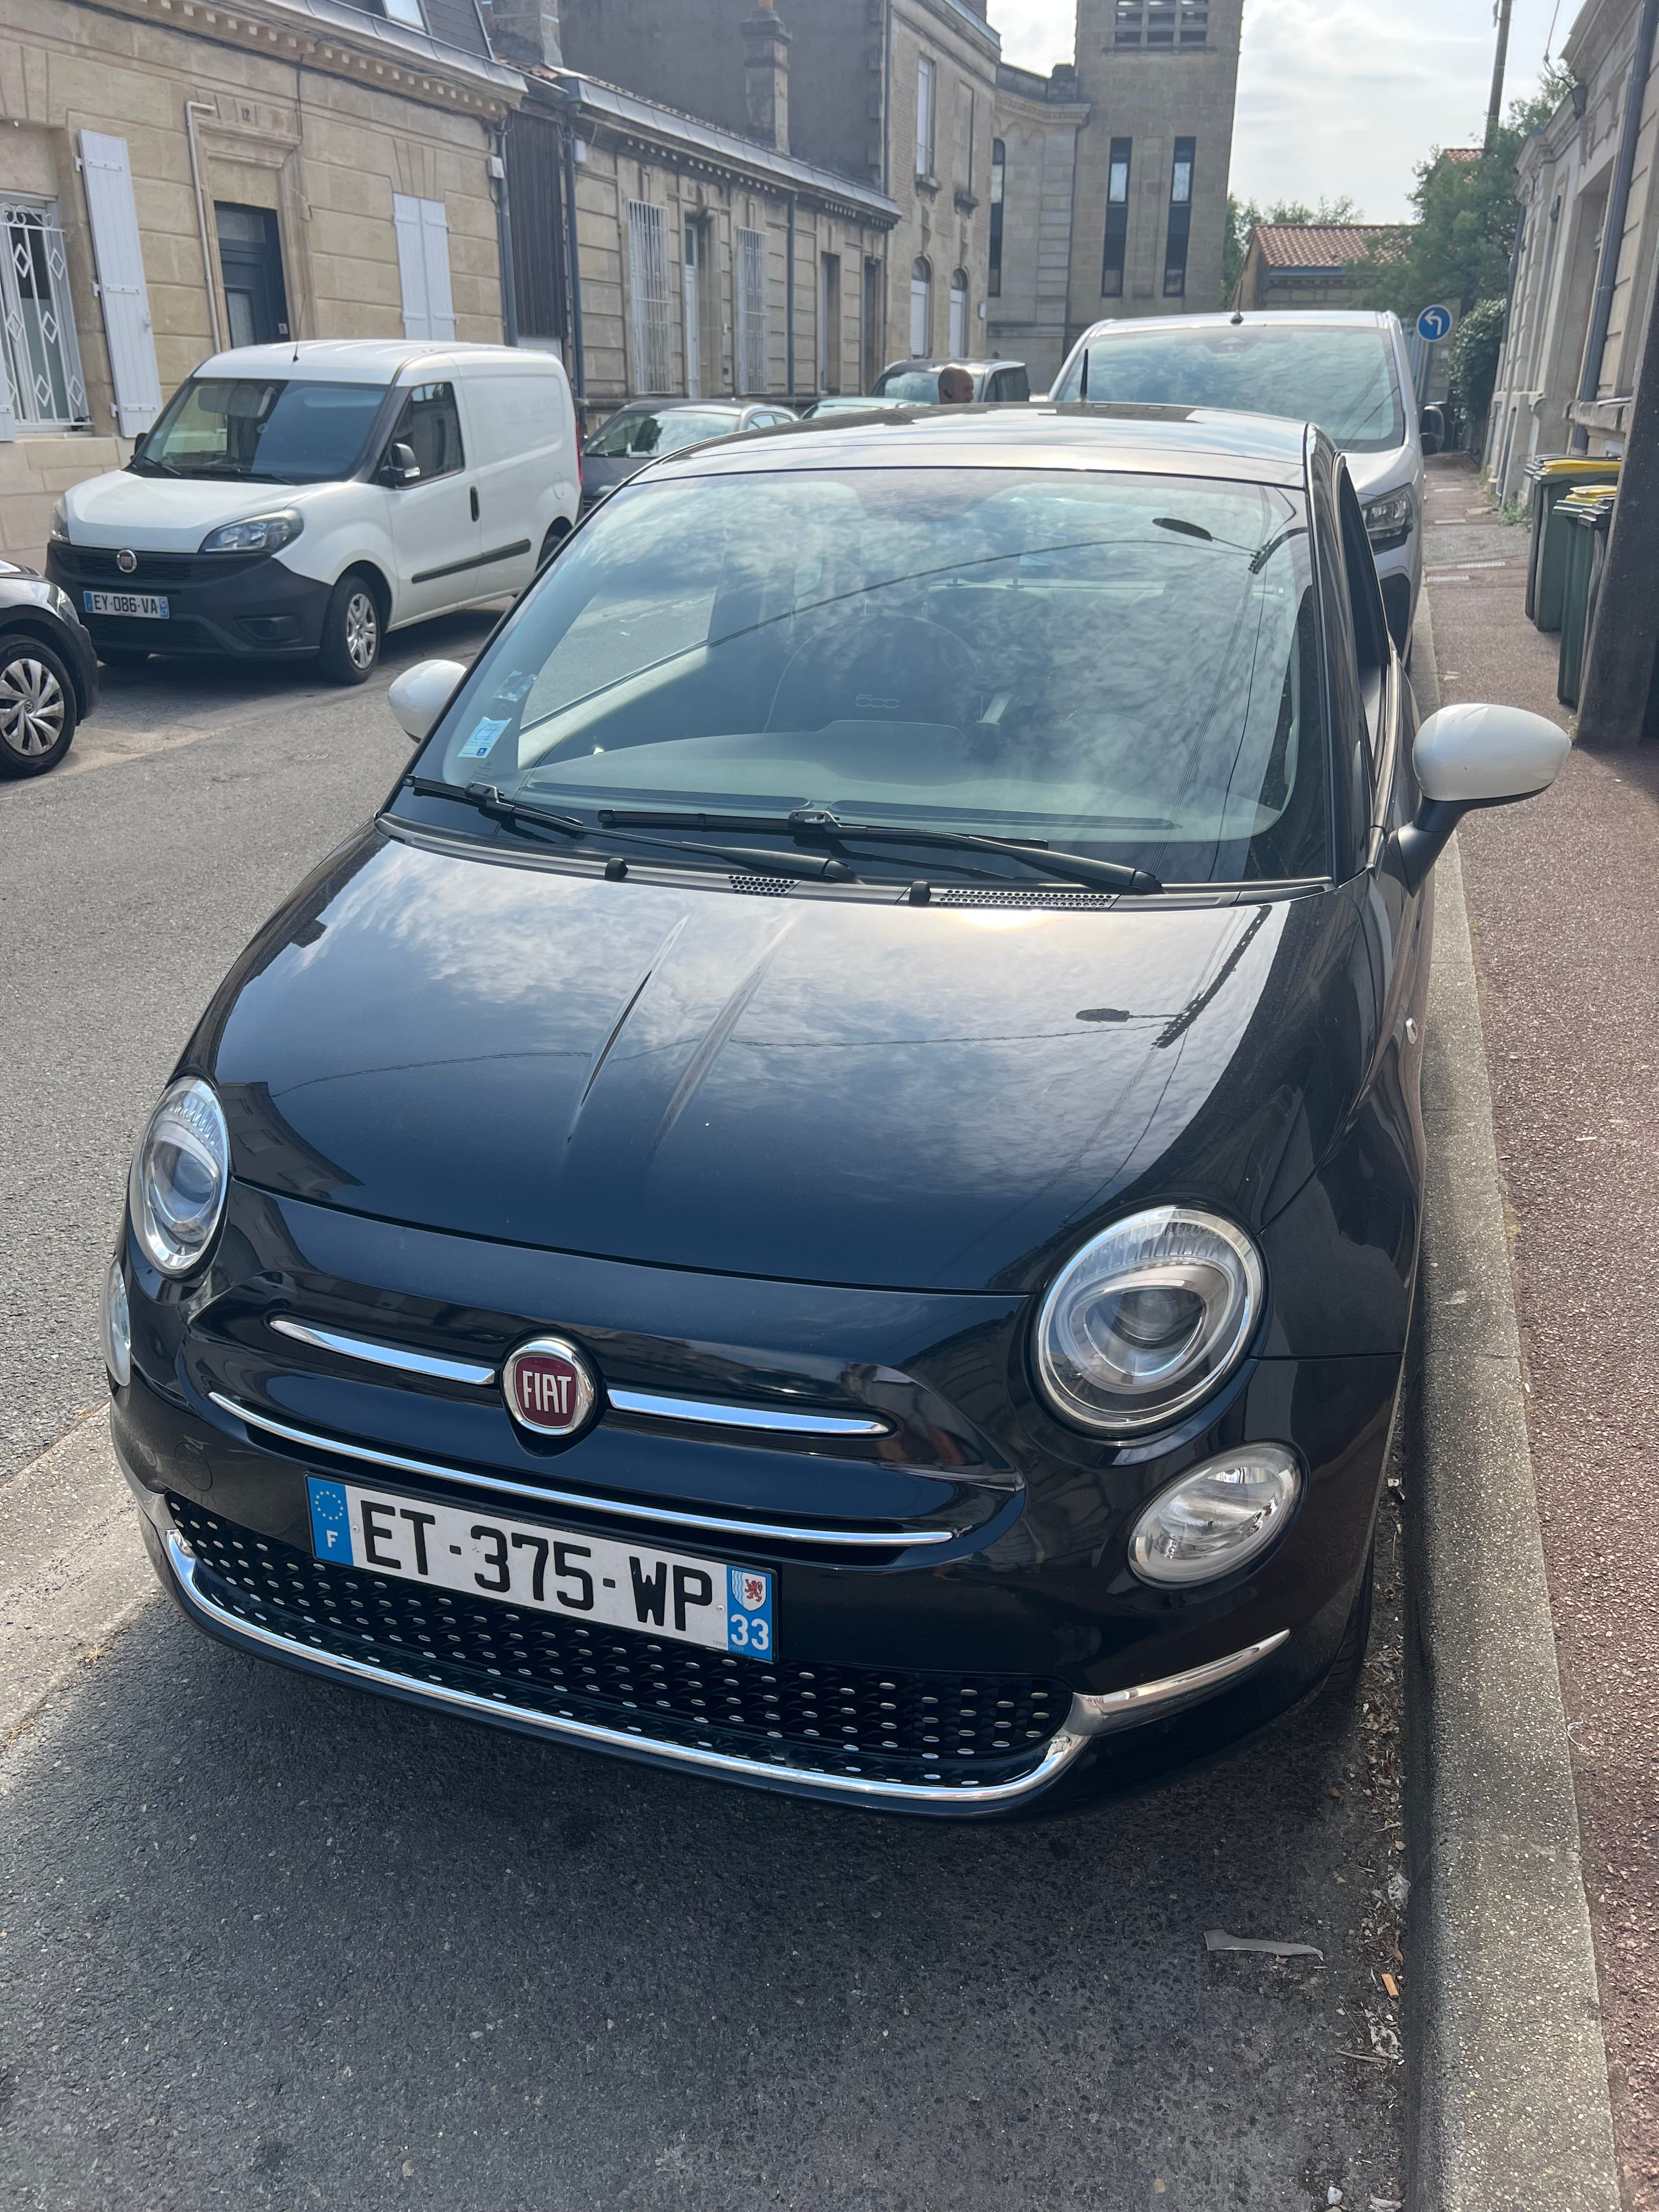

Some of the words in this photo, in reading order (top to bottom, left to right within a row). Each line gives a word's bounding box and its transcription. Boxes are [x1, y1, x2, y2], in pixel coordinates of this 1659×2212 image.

[94, 595, 158, 614] EY-086-VA
[855, 694, 900, 709] 500
[522, 1370, 572, 1414] FIAT
[326, 1530, 338, 1548] F
[360, 1500, 713, 1632] ET-375-WP
[730, 1613, 769, 1651] 33
